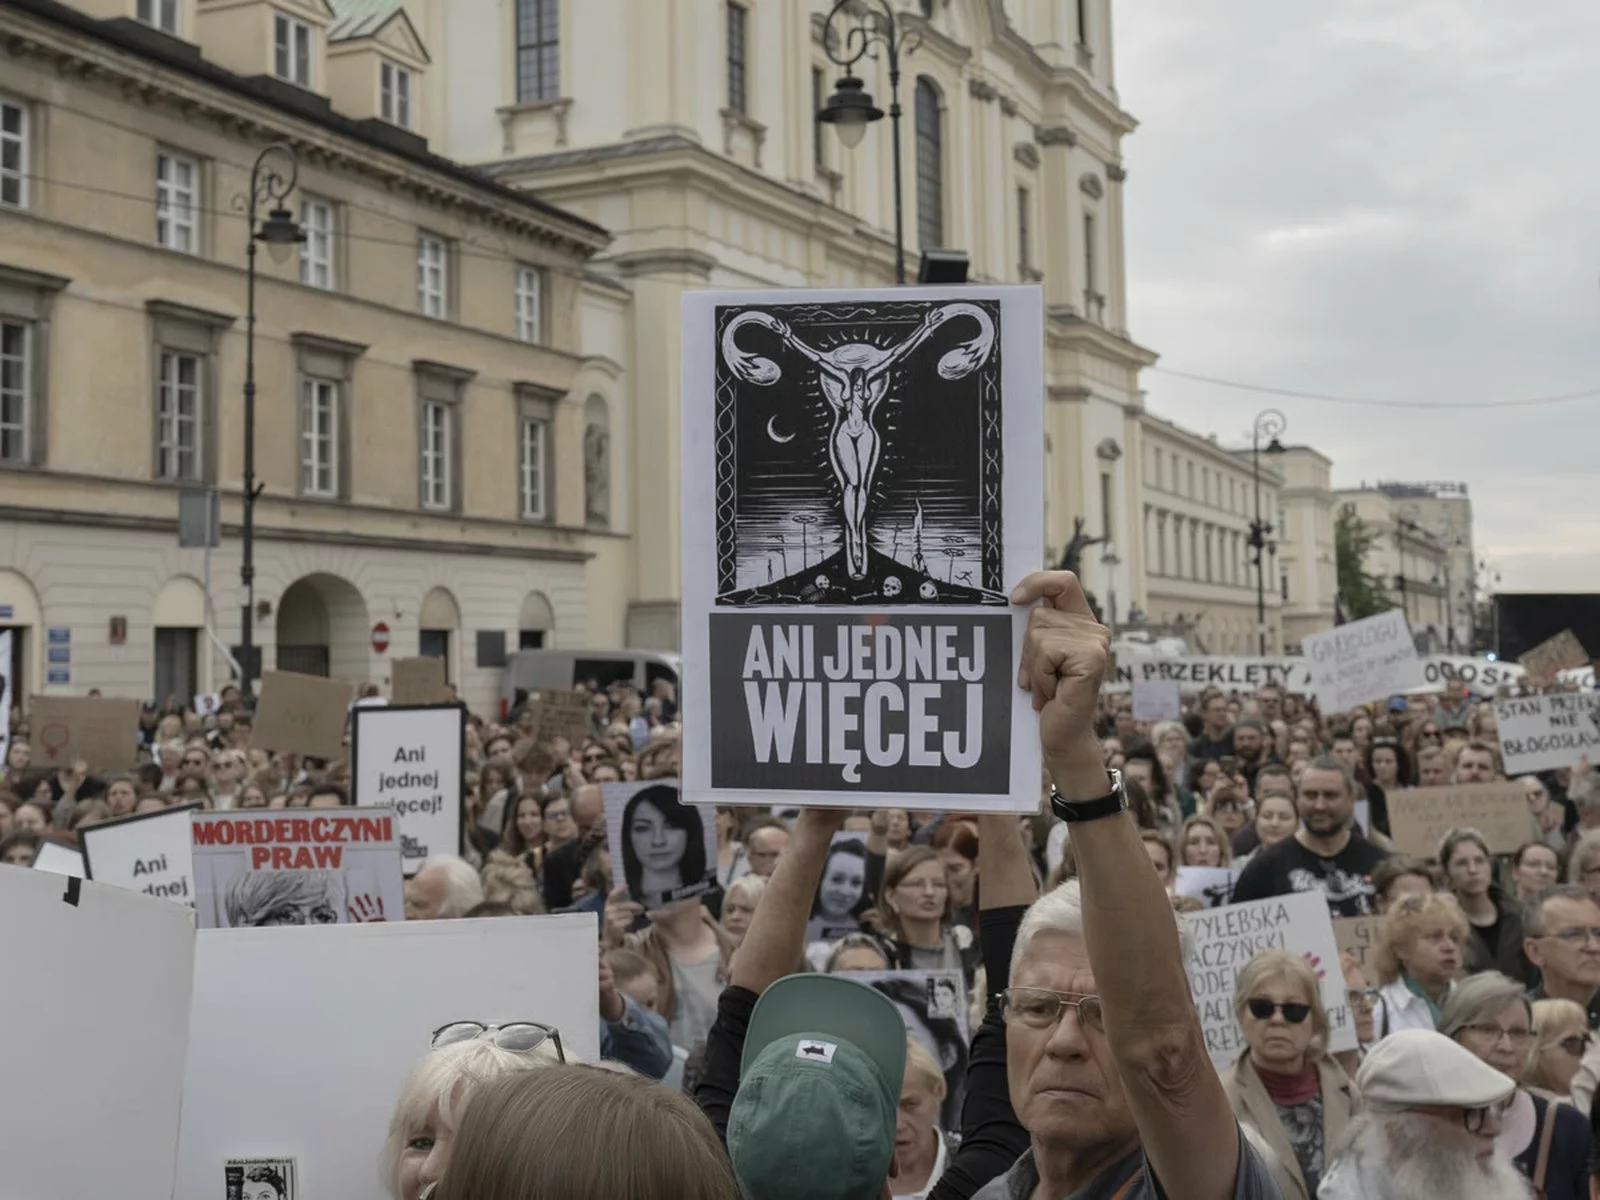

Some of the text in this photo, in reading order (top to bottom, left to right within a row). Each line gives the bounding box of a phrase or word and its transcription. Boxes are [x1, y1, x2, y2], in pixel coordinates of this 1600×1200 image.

[742, 624, 986, 682] ANI JEDNEJ
[1549, 712, 1578, 728] NIE
[743, 681, 984, 784] WIĘCEJ
[393, 745, 425, 763] Ani
[379, 770, 439, 793] jednej
[192, 816, 393, 846] MORDERCZYNI
[133, 853, 168, 877] Ani
[251, 846, 344, 871] PRAW
